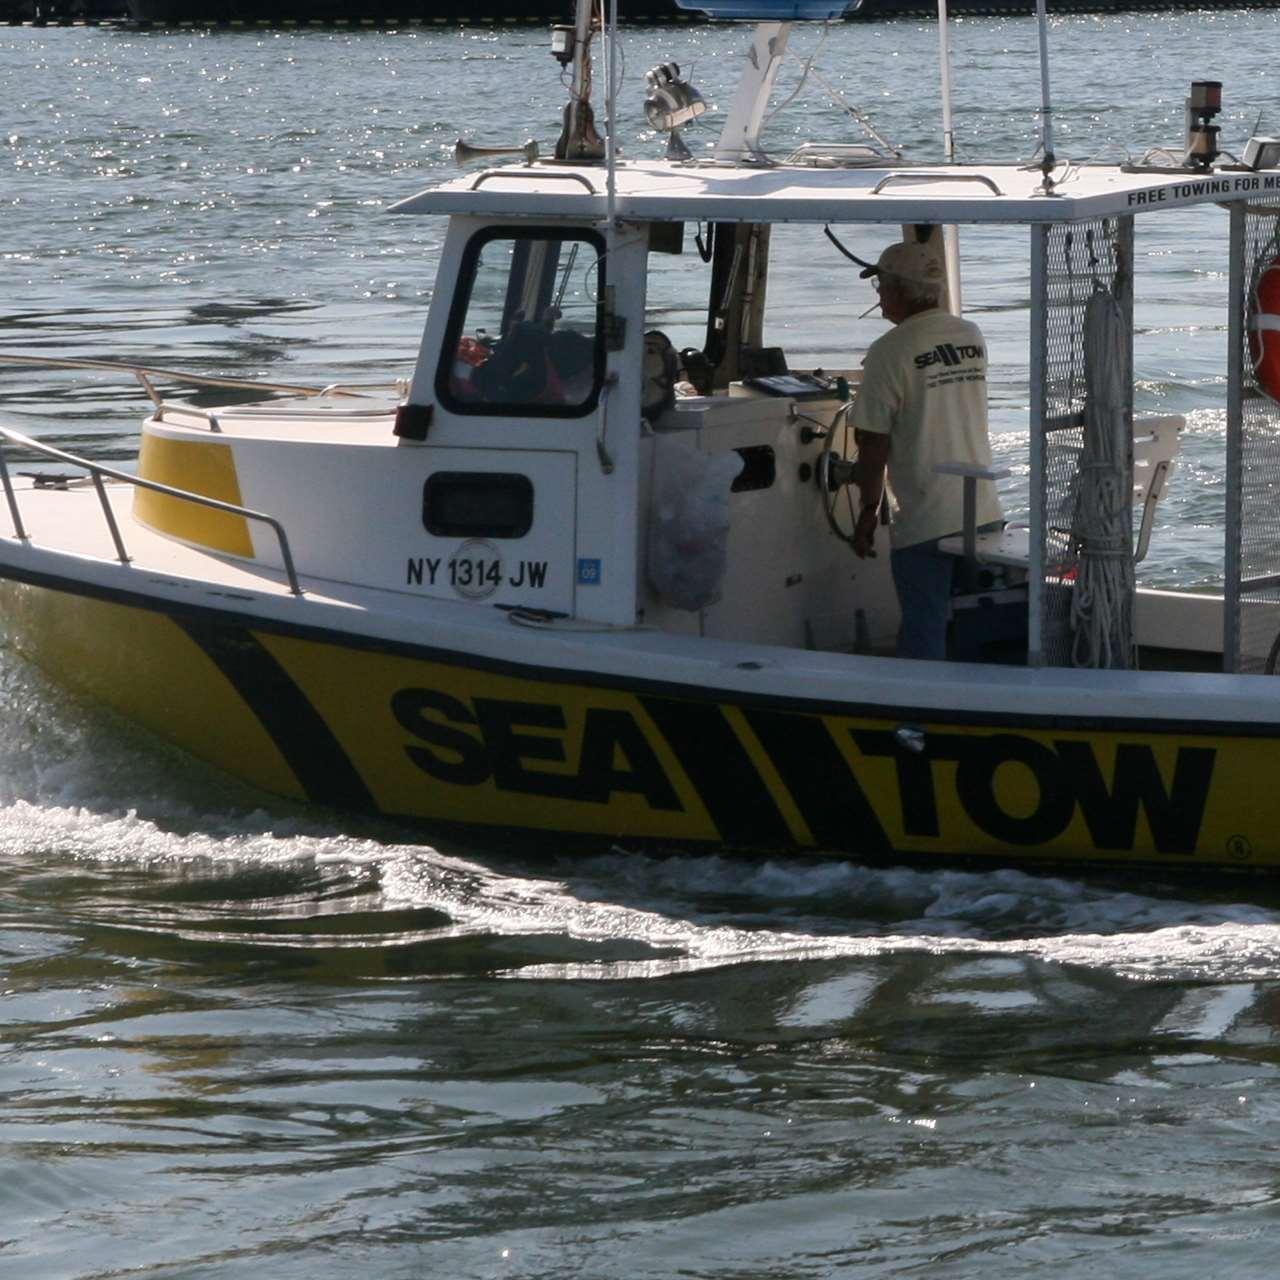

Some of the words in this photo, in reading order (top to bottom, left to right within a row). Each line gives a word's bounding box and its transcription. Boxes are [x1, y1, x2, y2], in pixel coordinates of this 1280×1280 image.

[1127, 191, 1166, 206] FREE
[1172, 179, 1230, 199] TOWING
[1234, 177, 1259, 192] FOR
[913, 352, 941, 369] SEA
[406, 558, 441, 586] NY
[448, 559, 502, 587] 1314
[509, 561, 548, 588] JW
[388, 686, 686, 812] SEA
[846, 727, 1218, 855] TOW
